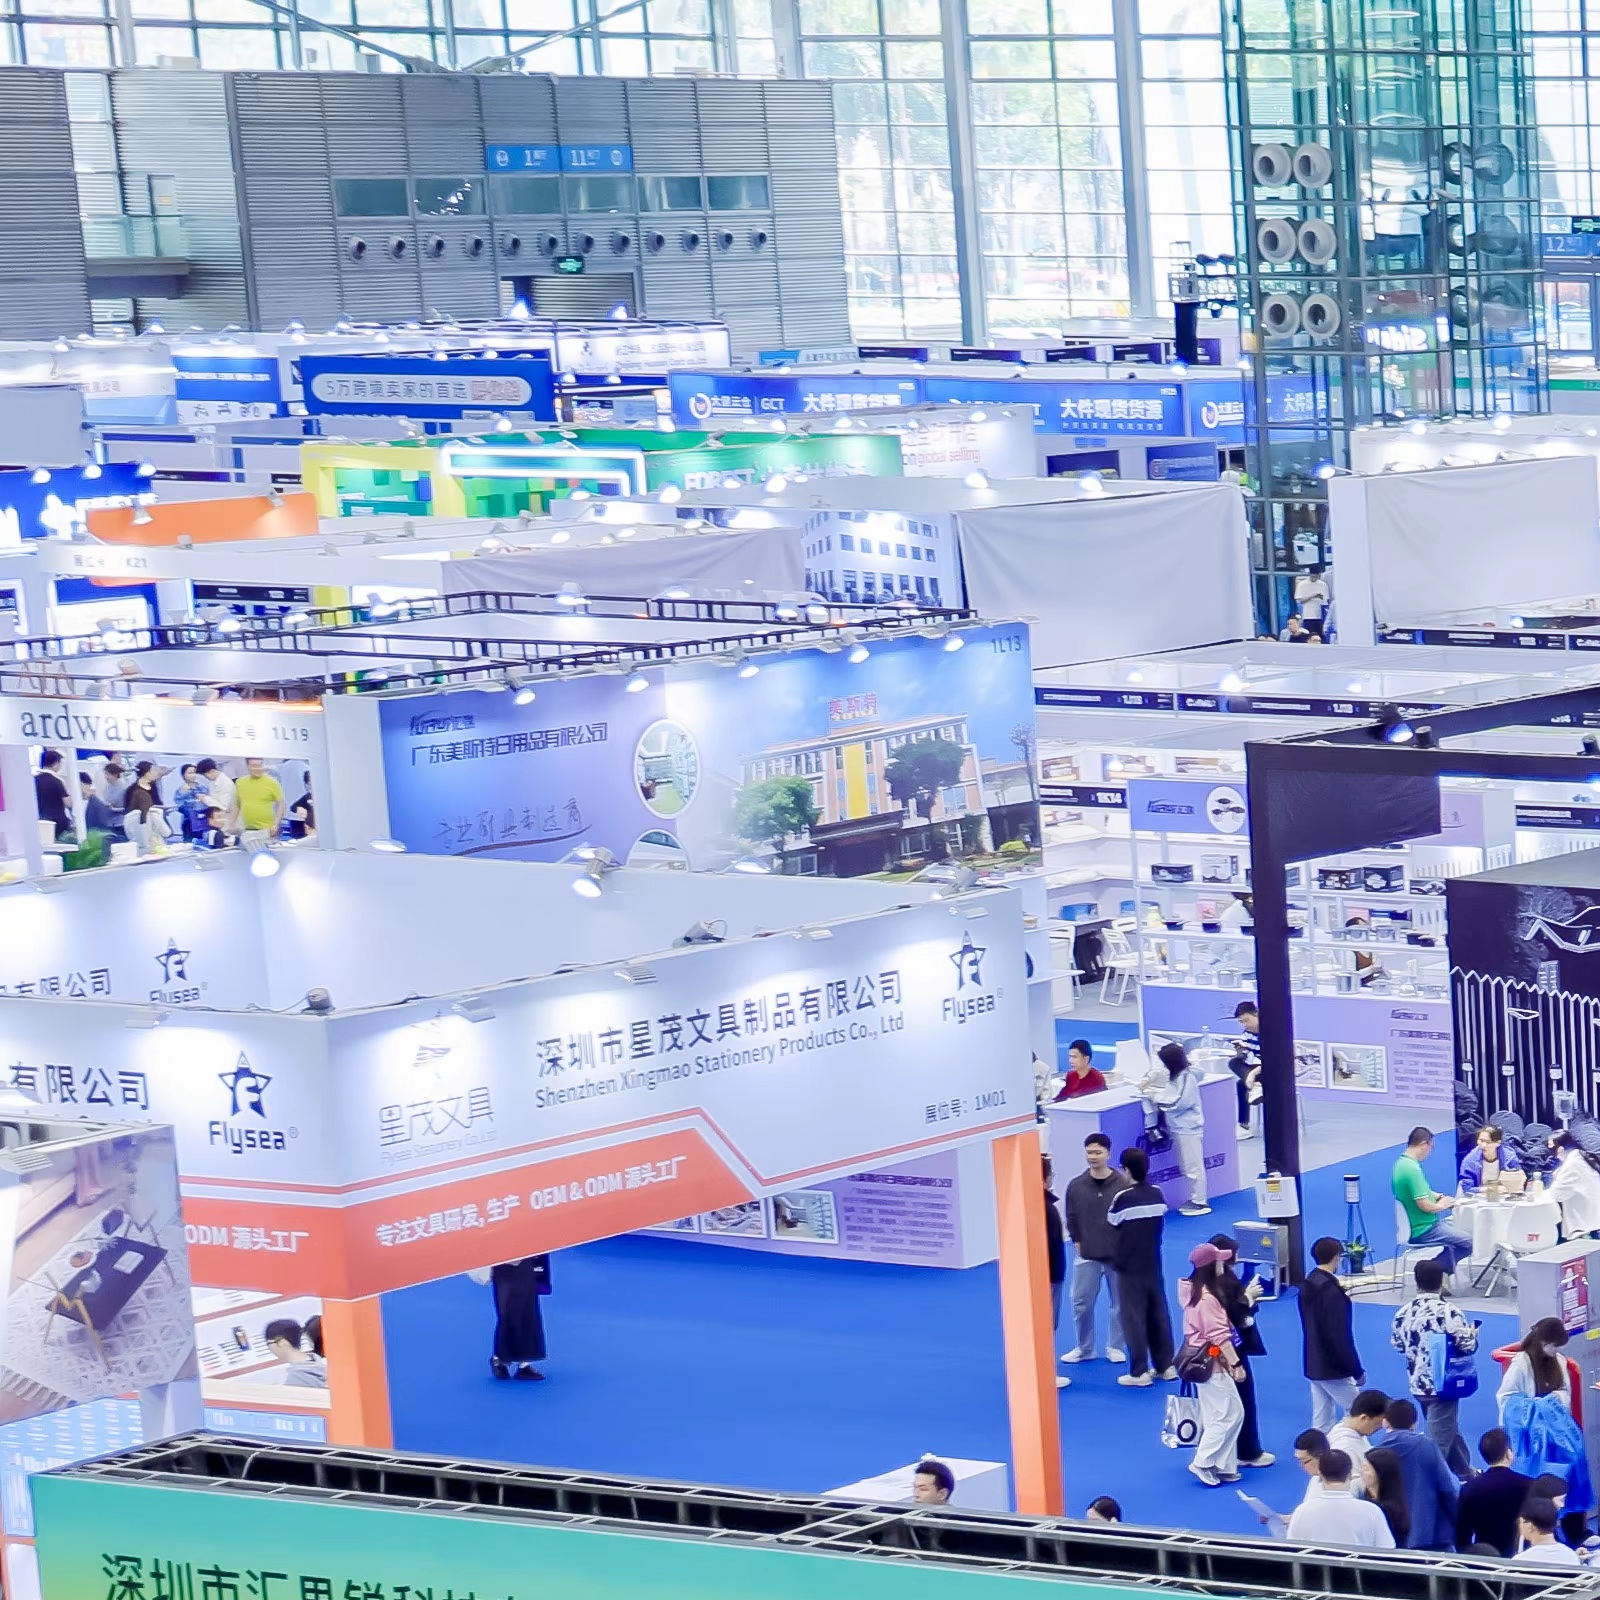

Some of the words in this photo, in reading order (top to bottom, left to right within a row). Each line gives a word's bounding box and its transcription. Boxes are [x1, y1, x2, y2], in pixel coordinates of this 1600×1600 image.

[1546, 237, 1566, 252] 12
[21, 706, 158, 743] ardware
[536, 968, 903, 1078] 深圳市星茂文具制品有限公司
[943, 992, 996, 1024] Flysea
[535, 1075, 618, 1109] Shenzhen
[619, 1062, 691, 1094] Xingmao
[695, 1042, 776, 1078] Stationery
[780, 1025, 847, 1058] Products
[881, 1012, 904, 1035] Ltd
[210, 1119, 286, 1155] Flysea
[379, 1086, 495, 1148] 星茂文具
[530, 1185, 567, 1212] OEM
[569, 1180, 584, 1201] &
[586, 1171, 624, 1198] ODM
[624, 1155, 687, 1191] 源头工厂
